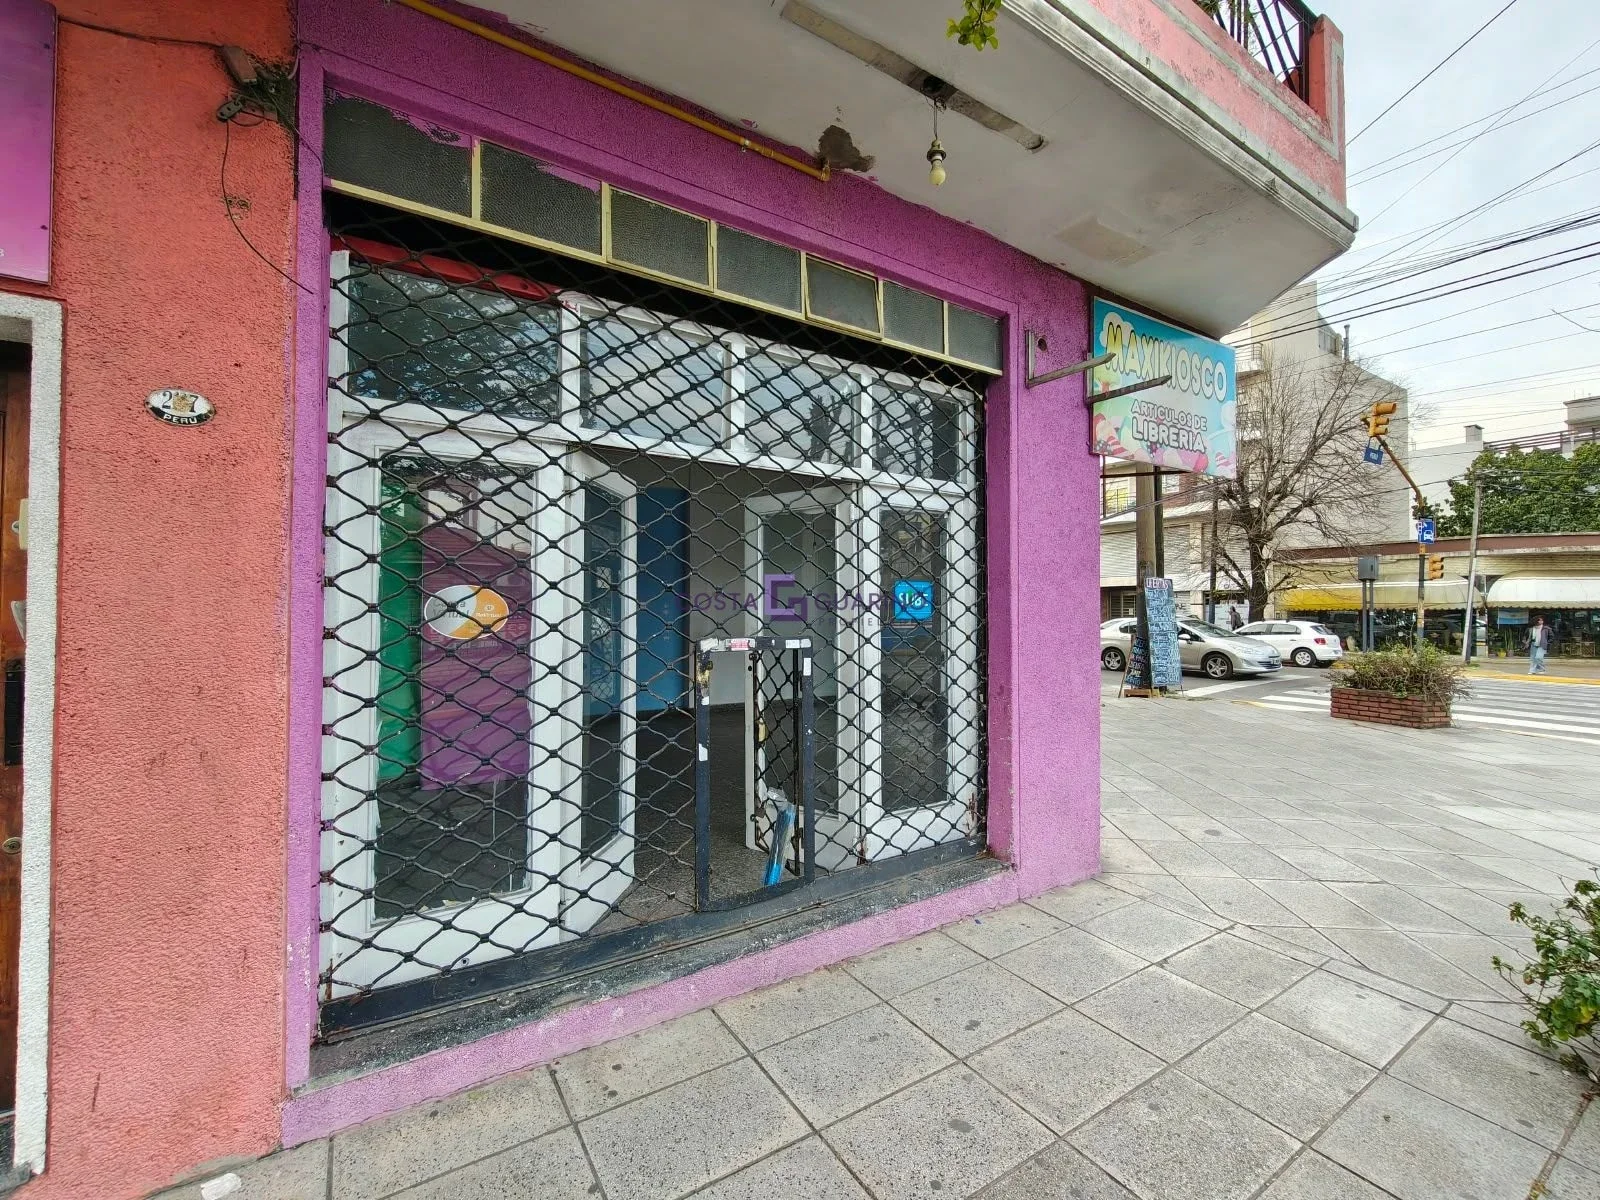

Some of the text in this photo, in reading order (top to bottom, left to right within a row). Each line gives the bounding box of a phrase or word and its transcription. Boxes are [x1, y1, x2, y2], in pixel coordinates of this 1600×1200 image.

[1105, 321, 1228, 402] MAXIKIOSCO
[161, 390, 199, 413] 27
[1131, 400, 1208, 432] ARTICULOS DE
[1131, 416, 1206, 454] LIBRERIA
